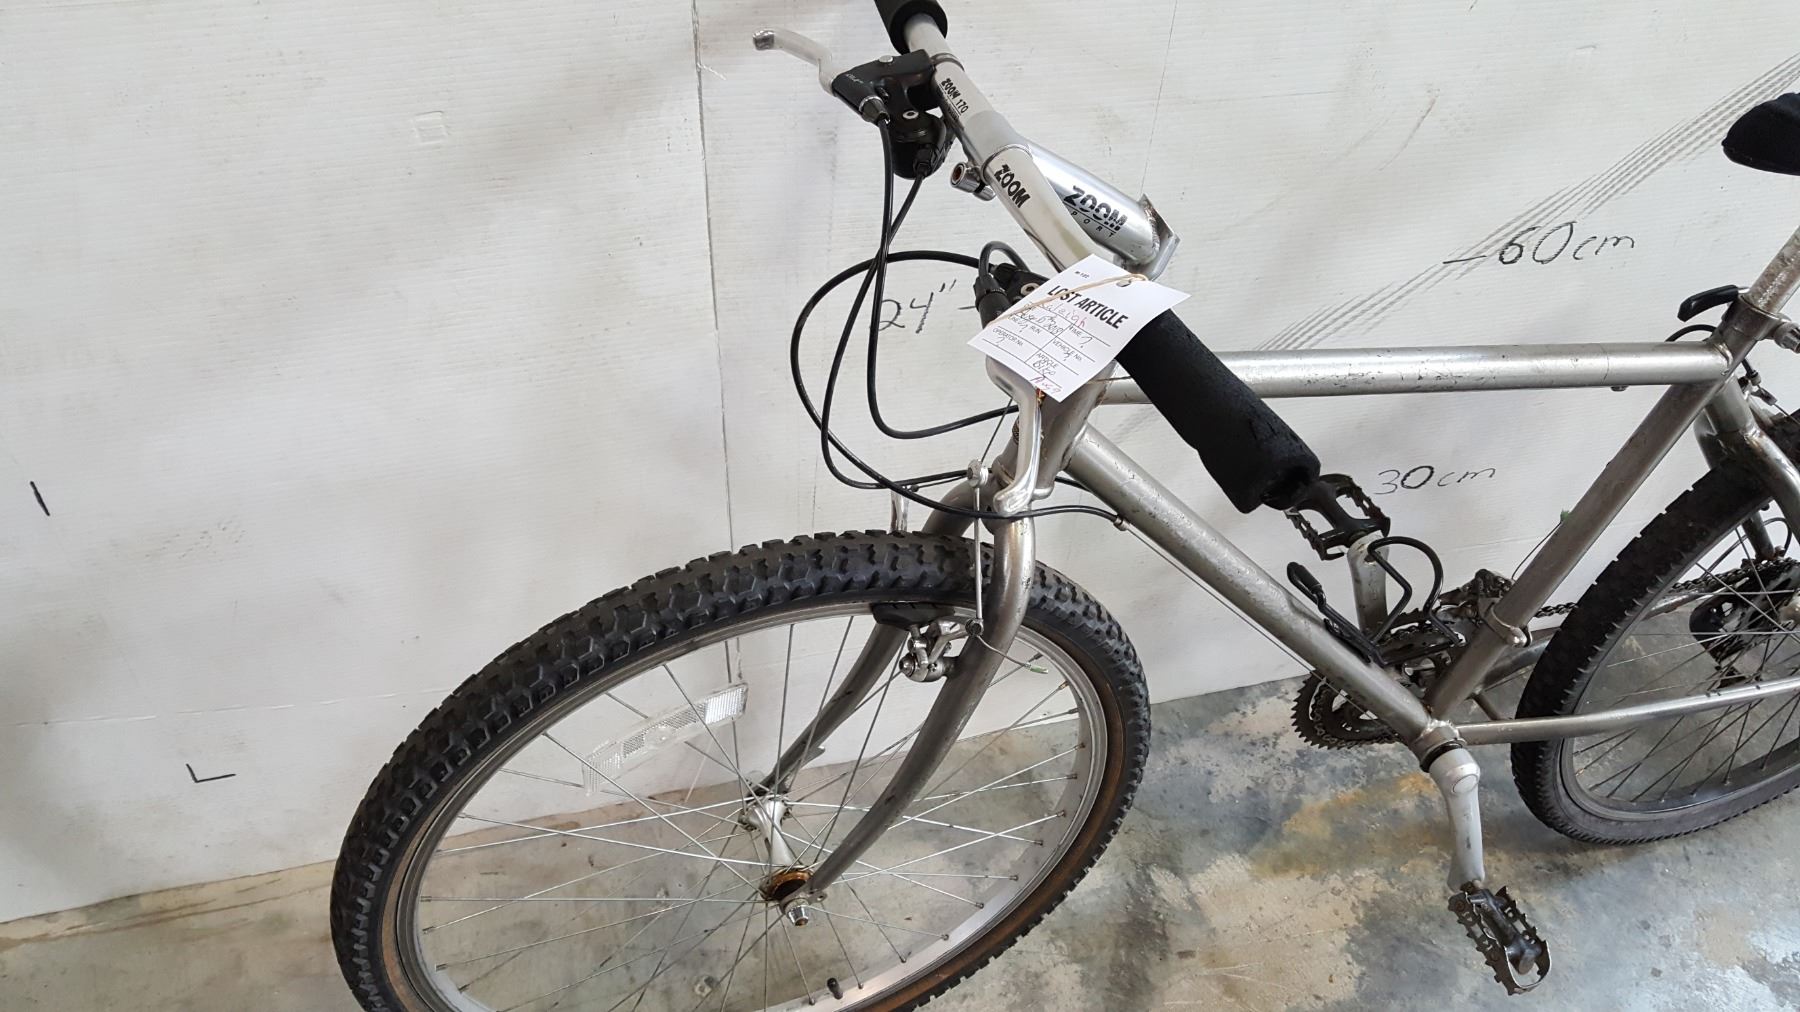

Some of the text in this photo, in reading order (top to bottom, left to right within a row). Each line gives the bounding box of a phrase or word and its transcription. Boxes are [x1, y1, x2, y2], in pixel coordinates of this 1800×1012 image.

[941, 78, 961, 100] ZOOM
[956, 99, 969, 114] 170
[994, 164, 1031, 208] ZOOM
[1063, 185, 1128, 232] ZOOM
[1070, 210, 1115, 238] PORT
[1073, 297, 1129, 329] ARTICLE
[1036, 353, 1059, 369] ARTICLE
